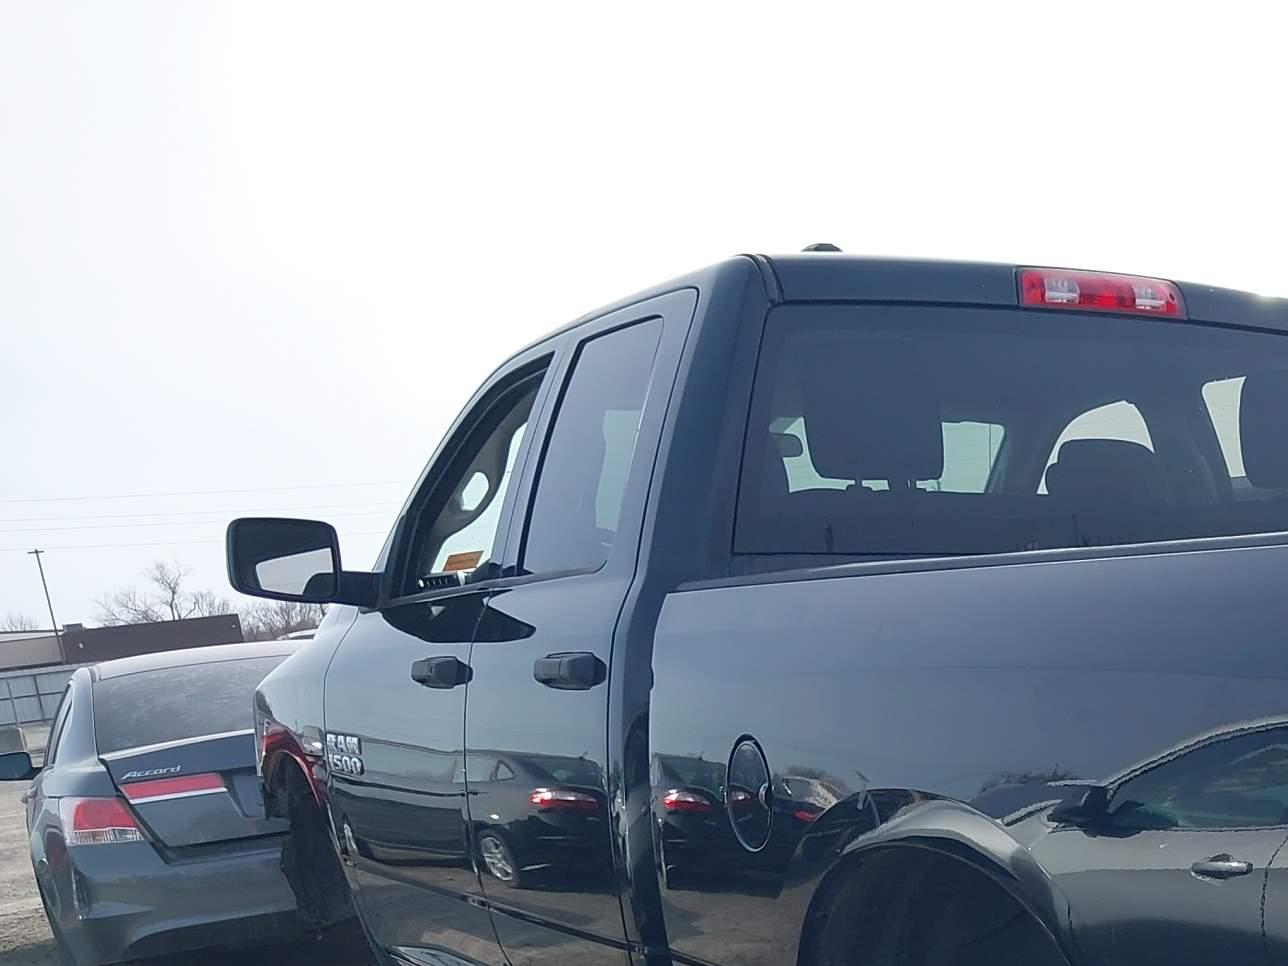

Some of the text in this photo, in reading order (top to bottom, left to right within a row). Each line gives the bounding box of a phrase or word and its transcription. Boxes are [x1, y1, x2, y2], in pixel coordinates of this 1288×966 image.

[327, 733, 360, 755] RAM
[121, 764, 182, 780] Accord
[329, 754, 362, 776] 1500
